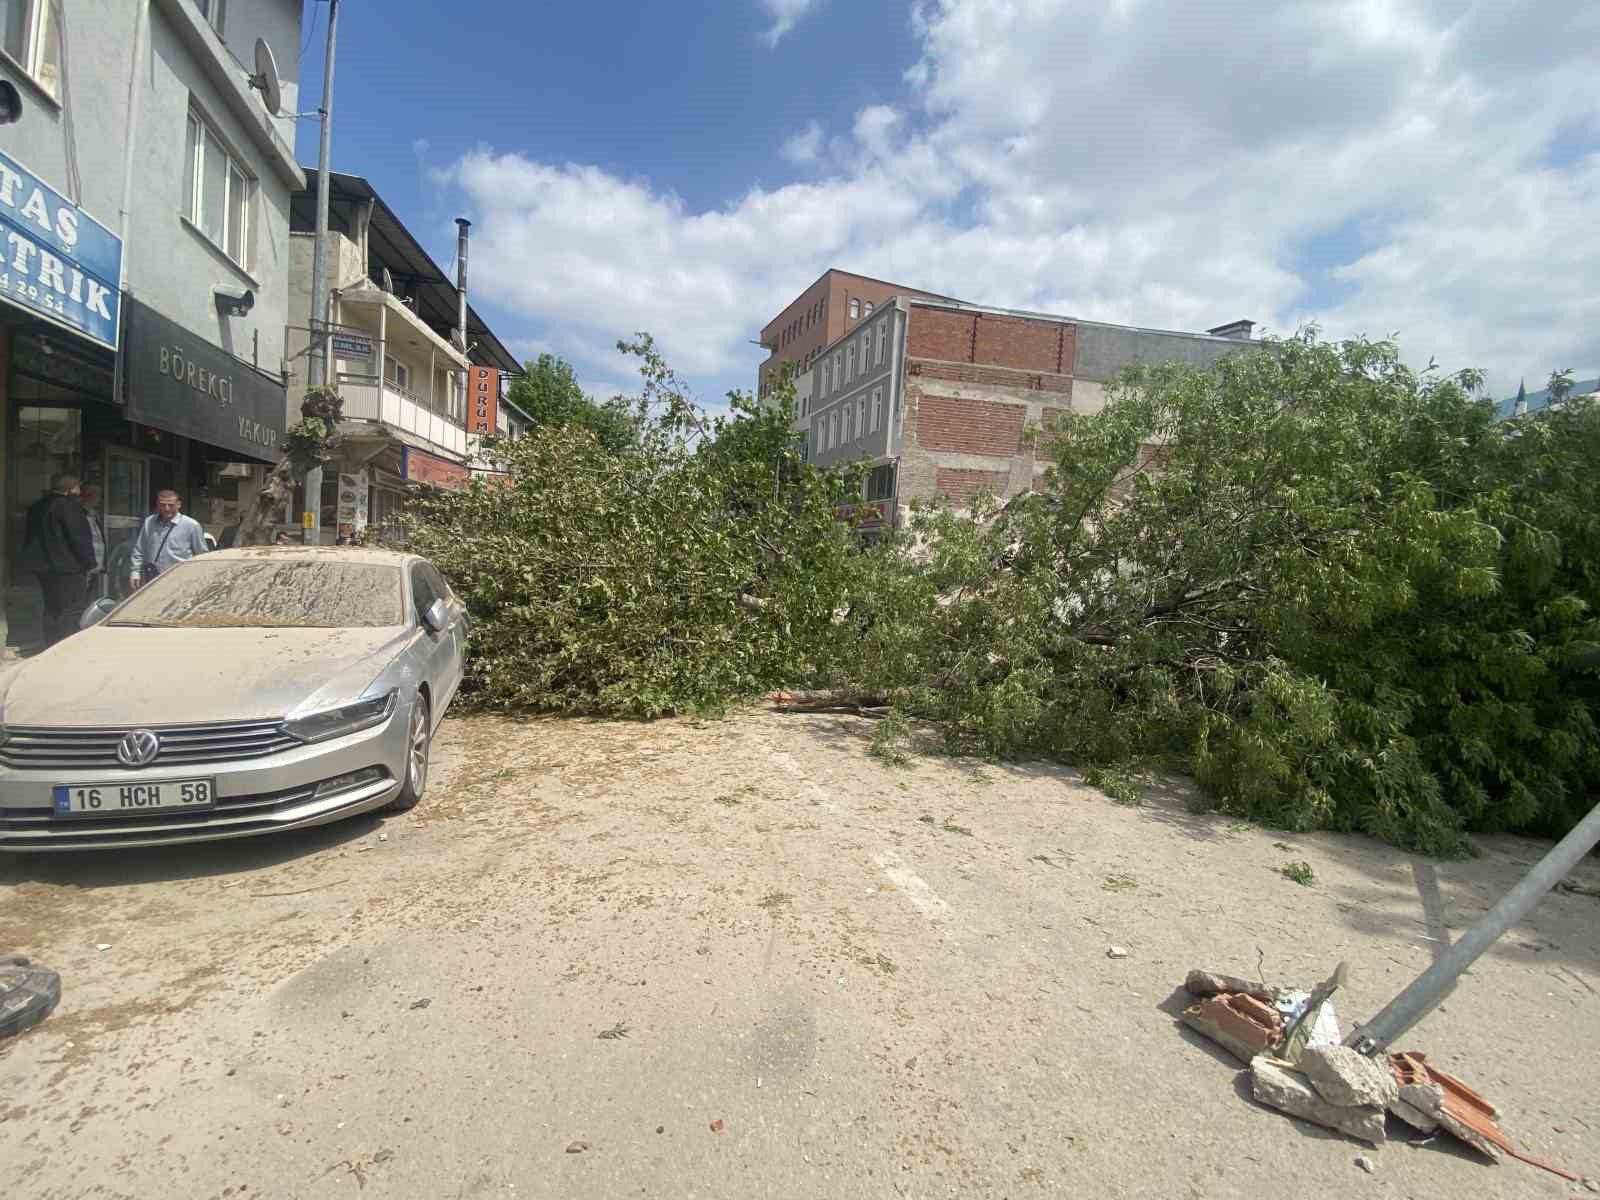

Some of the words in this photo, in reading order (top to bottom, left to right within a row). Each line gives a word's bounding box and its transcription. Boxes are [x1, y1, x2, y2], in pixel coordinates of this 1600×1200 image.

[0, 223, 111, 320] TRİK
[159, 345, 233, 408] BÖREKÇİ
[238, 415, 277, 447] YAKUP
[77, 789, 102, 809] 16
[119, 786, 161, 808] HCH
[180, 782, 209, 803] 58
